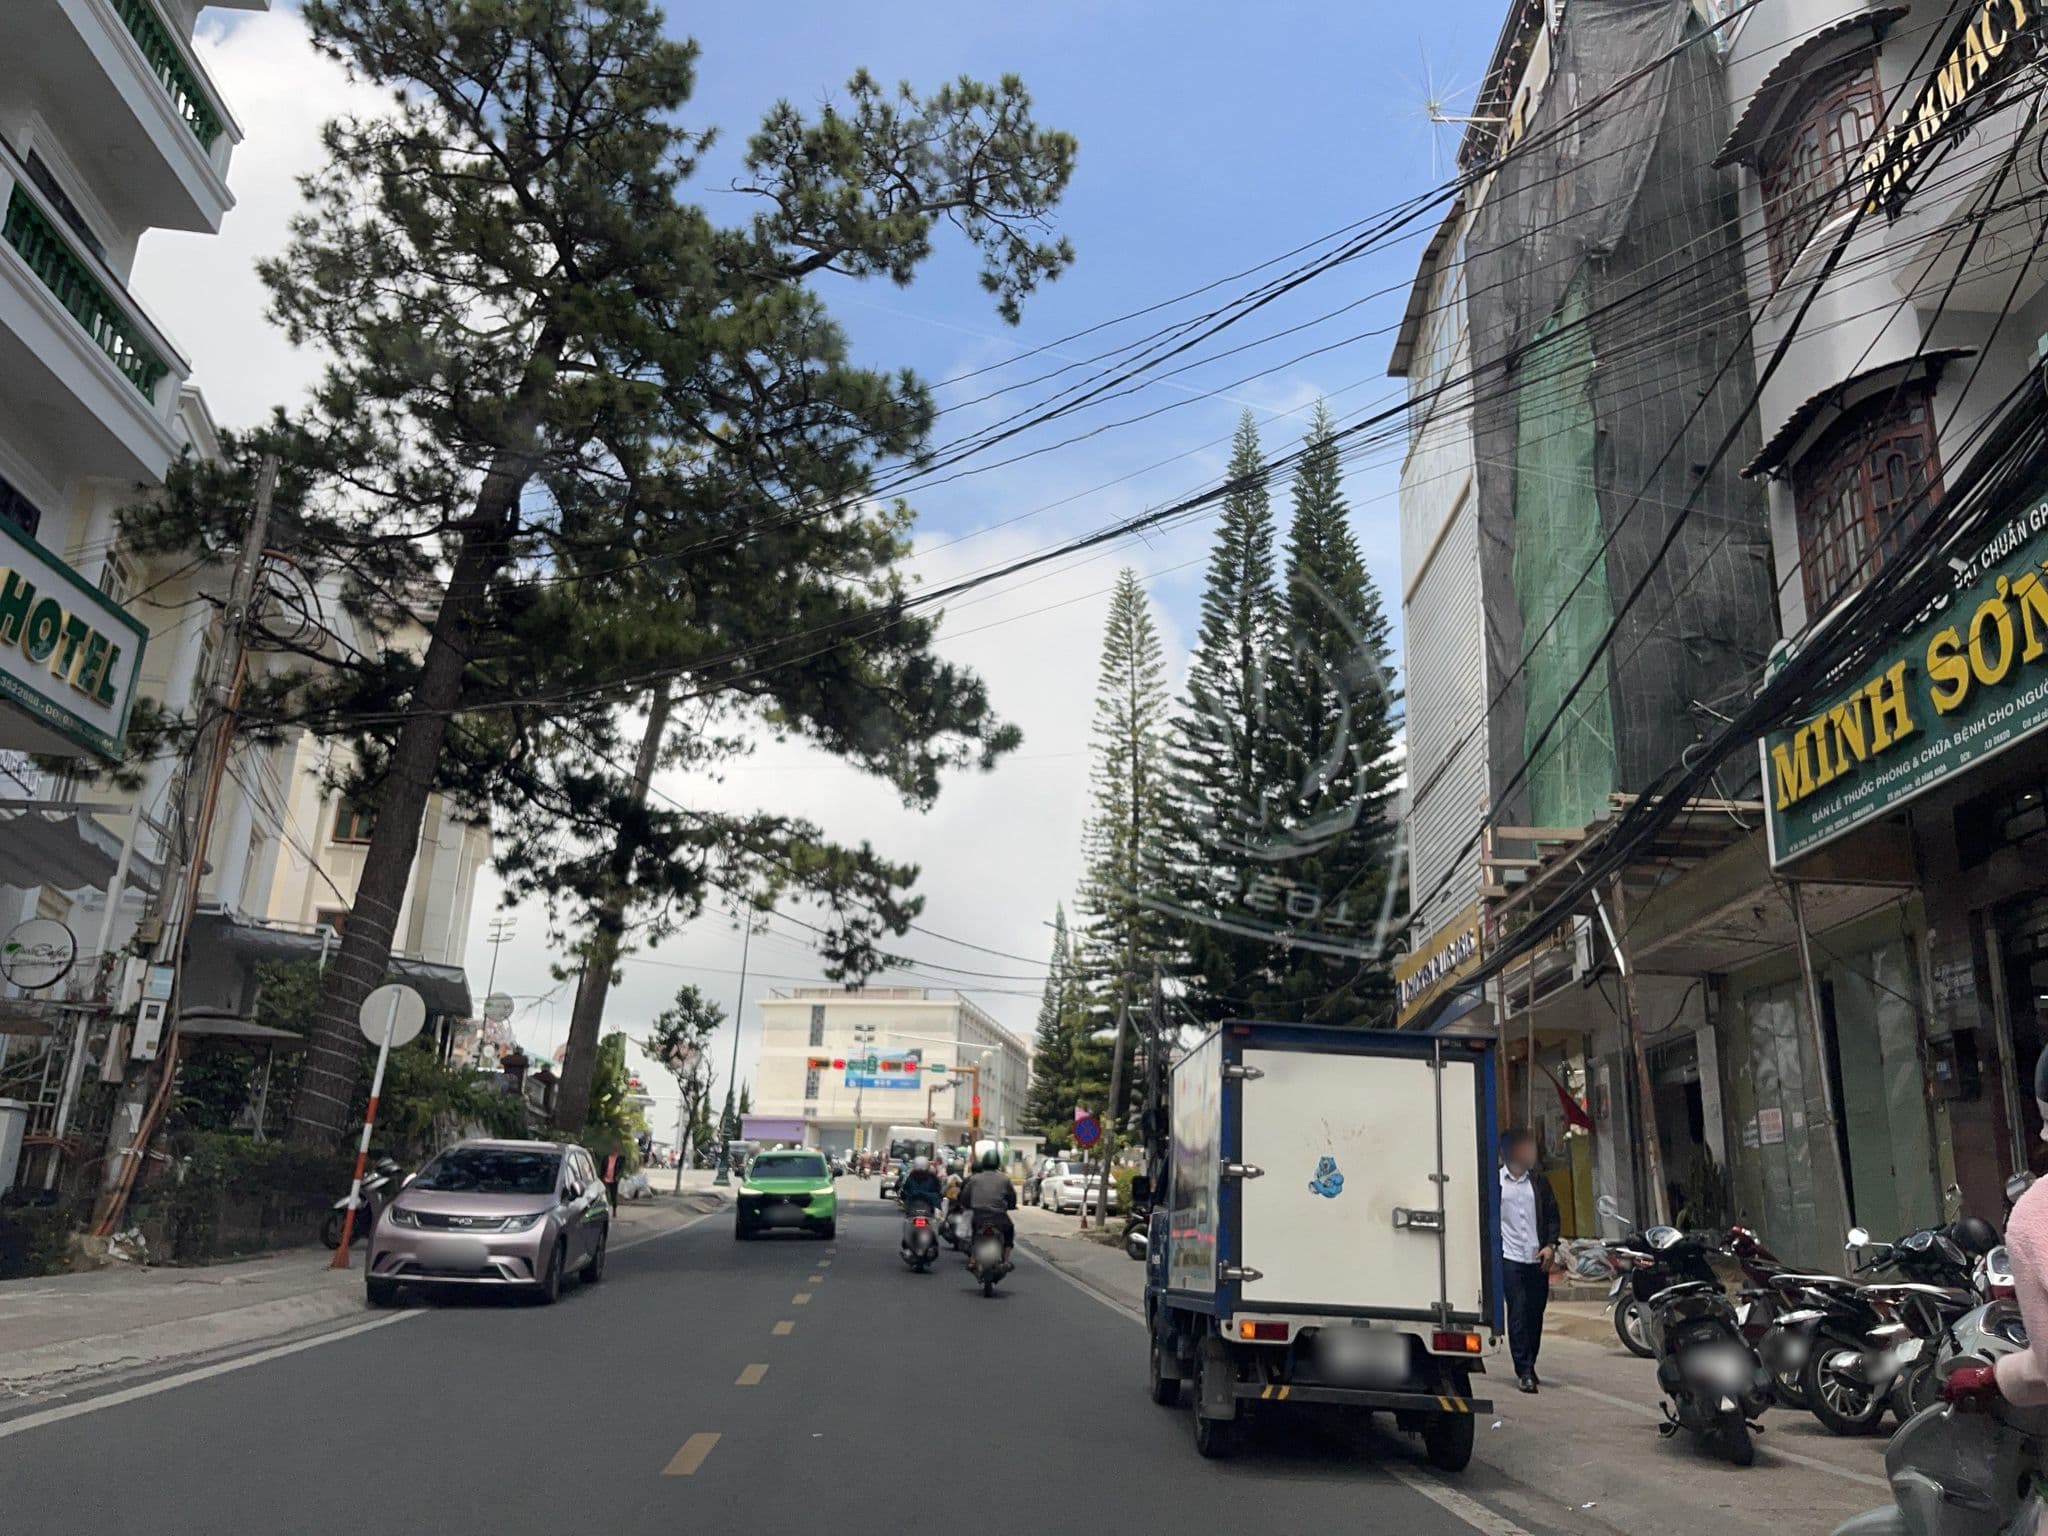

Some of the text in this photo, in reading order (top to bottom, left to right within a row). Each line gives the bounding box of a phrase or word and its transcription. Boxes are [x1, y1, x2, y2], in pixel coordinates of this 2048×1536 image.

[0, 568, 121, 708] HOTEL
[1771, 659, 1913, 811] MINH
[1926, 561, 2048, 714] SƠN
[1843, 780, 1875, 805] THUỐC
[1921, 739, 1952, 763] CHỮA
[1953, 718, 1986, 745] BỆNH
[1987, 703, 2014, 726] CHO
